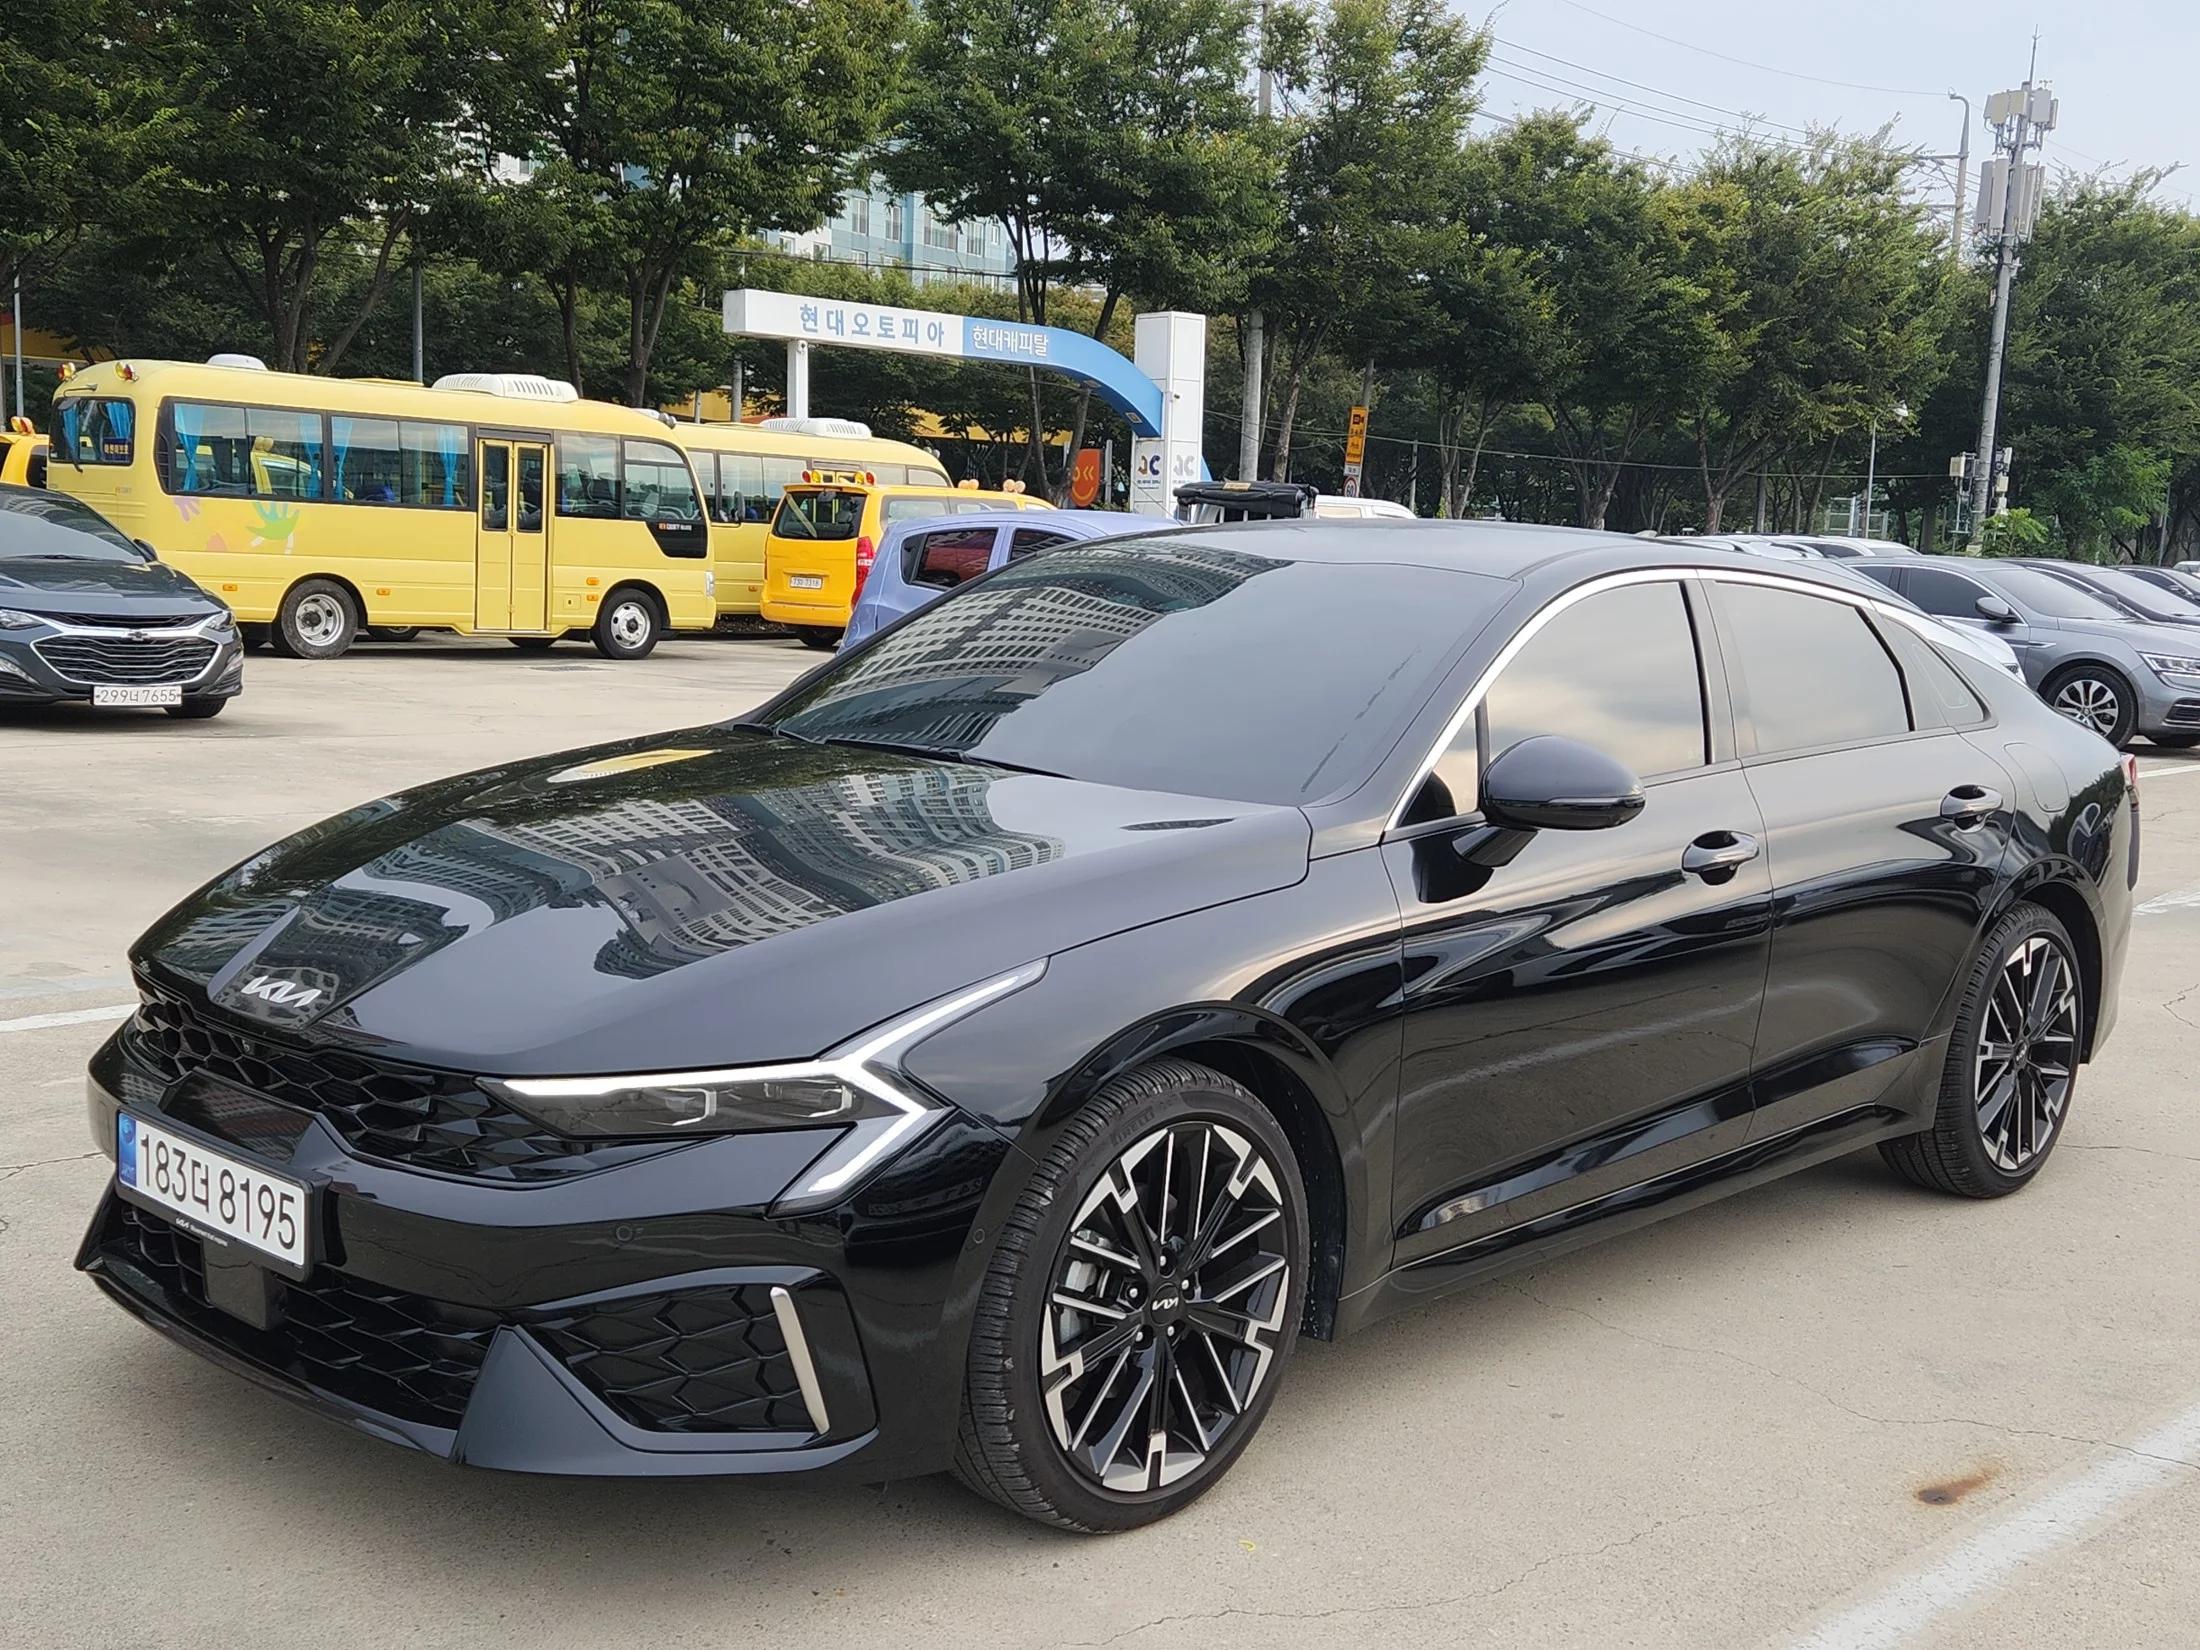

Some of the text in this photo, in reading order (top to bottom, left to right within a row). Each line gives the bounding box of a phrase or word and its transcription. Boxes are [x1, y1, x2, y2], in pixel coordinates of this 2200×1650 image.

[800, 303, 944, 347] 현대오토피아
[973, 325, 1048, 357] 현대캐피탈
[100, 689, 177, 703] 299너 7655
[141, 1134, 296, 1250] 183더 8195
